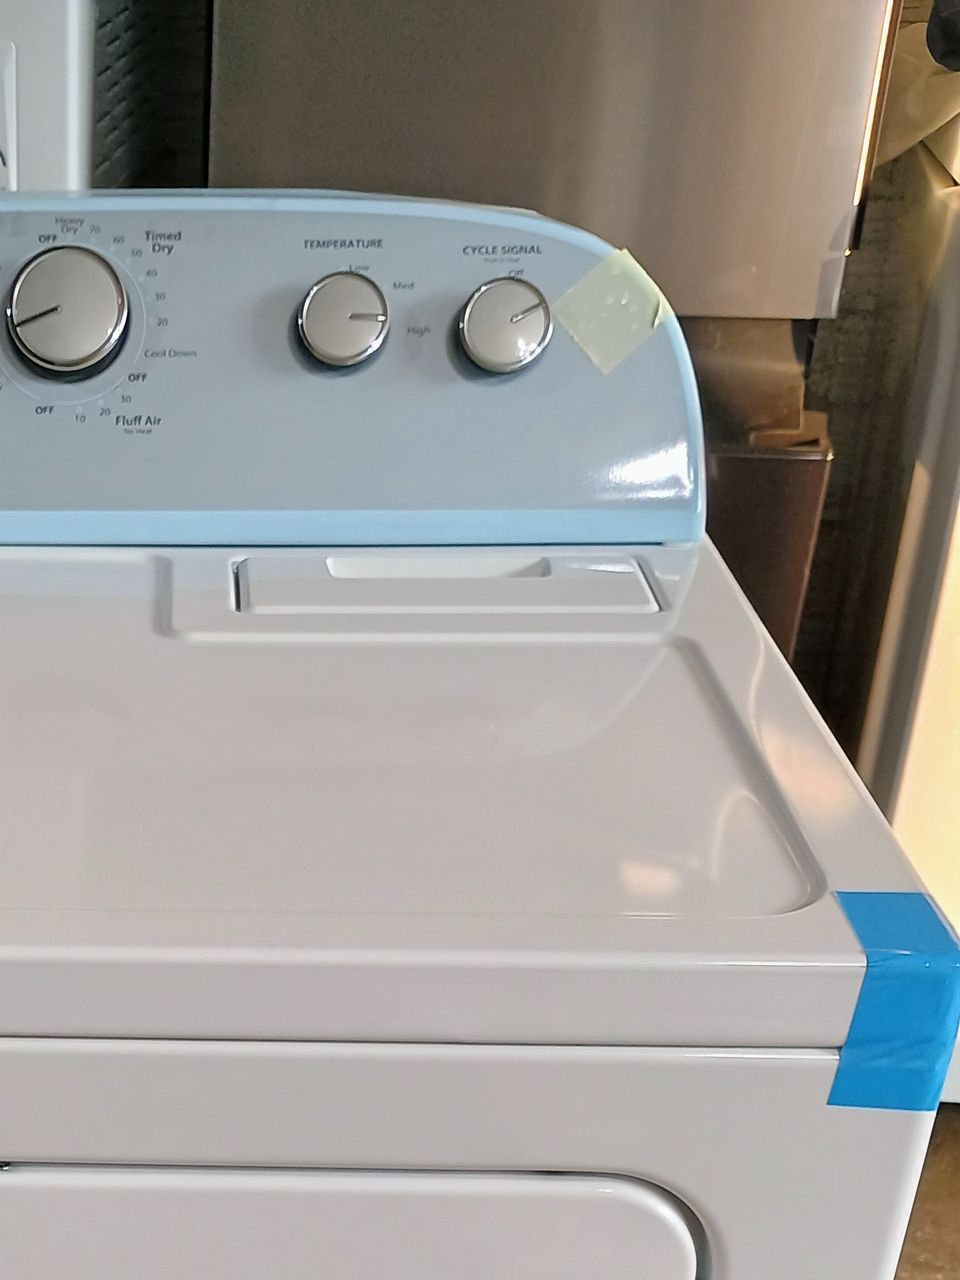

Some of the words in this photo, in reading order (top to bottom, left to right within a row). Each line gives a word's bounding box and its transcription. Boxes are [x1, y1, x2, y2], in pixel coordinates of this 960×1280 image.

[145, 231, 182, 242] Timed
[152, 243, 175, 256] Dry
[304, 239, 383, 249] TEMPERATURE
[463, 246, 497, 256] CYCLE
[501, 245, 542, 255] SIGNAL
[144, 348, 166, 358] Cool
[75, 413, 86, 423] 10
[115, 415, 143, 426] Fluff
[145, 415, 162, 426] Air
